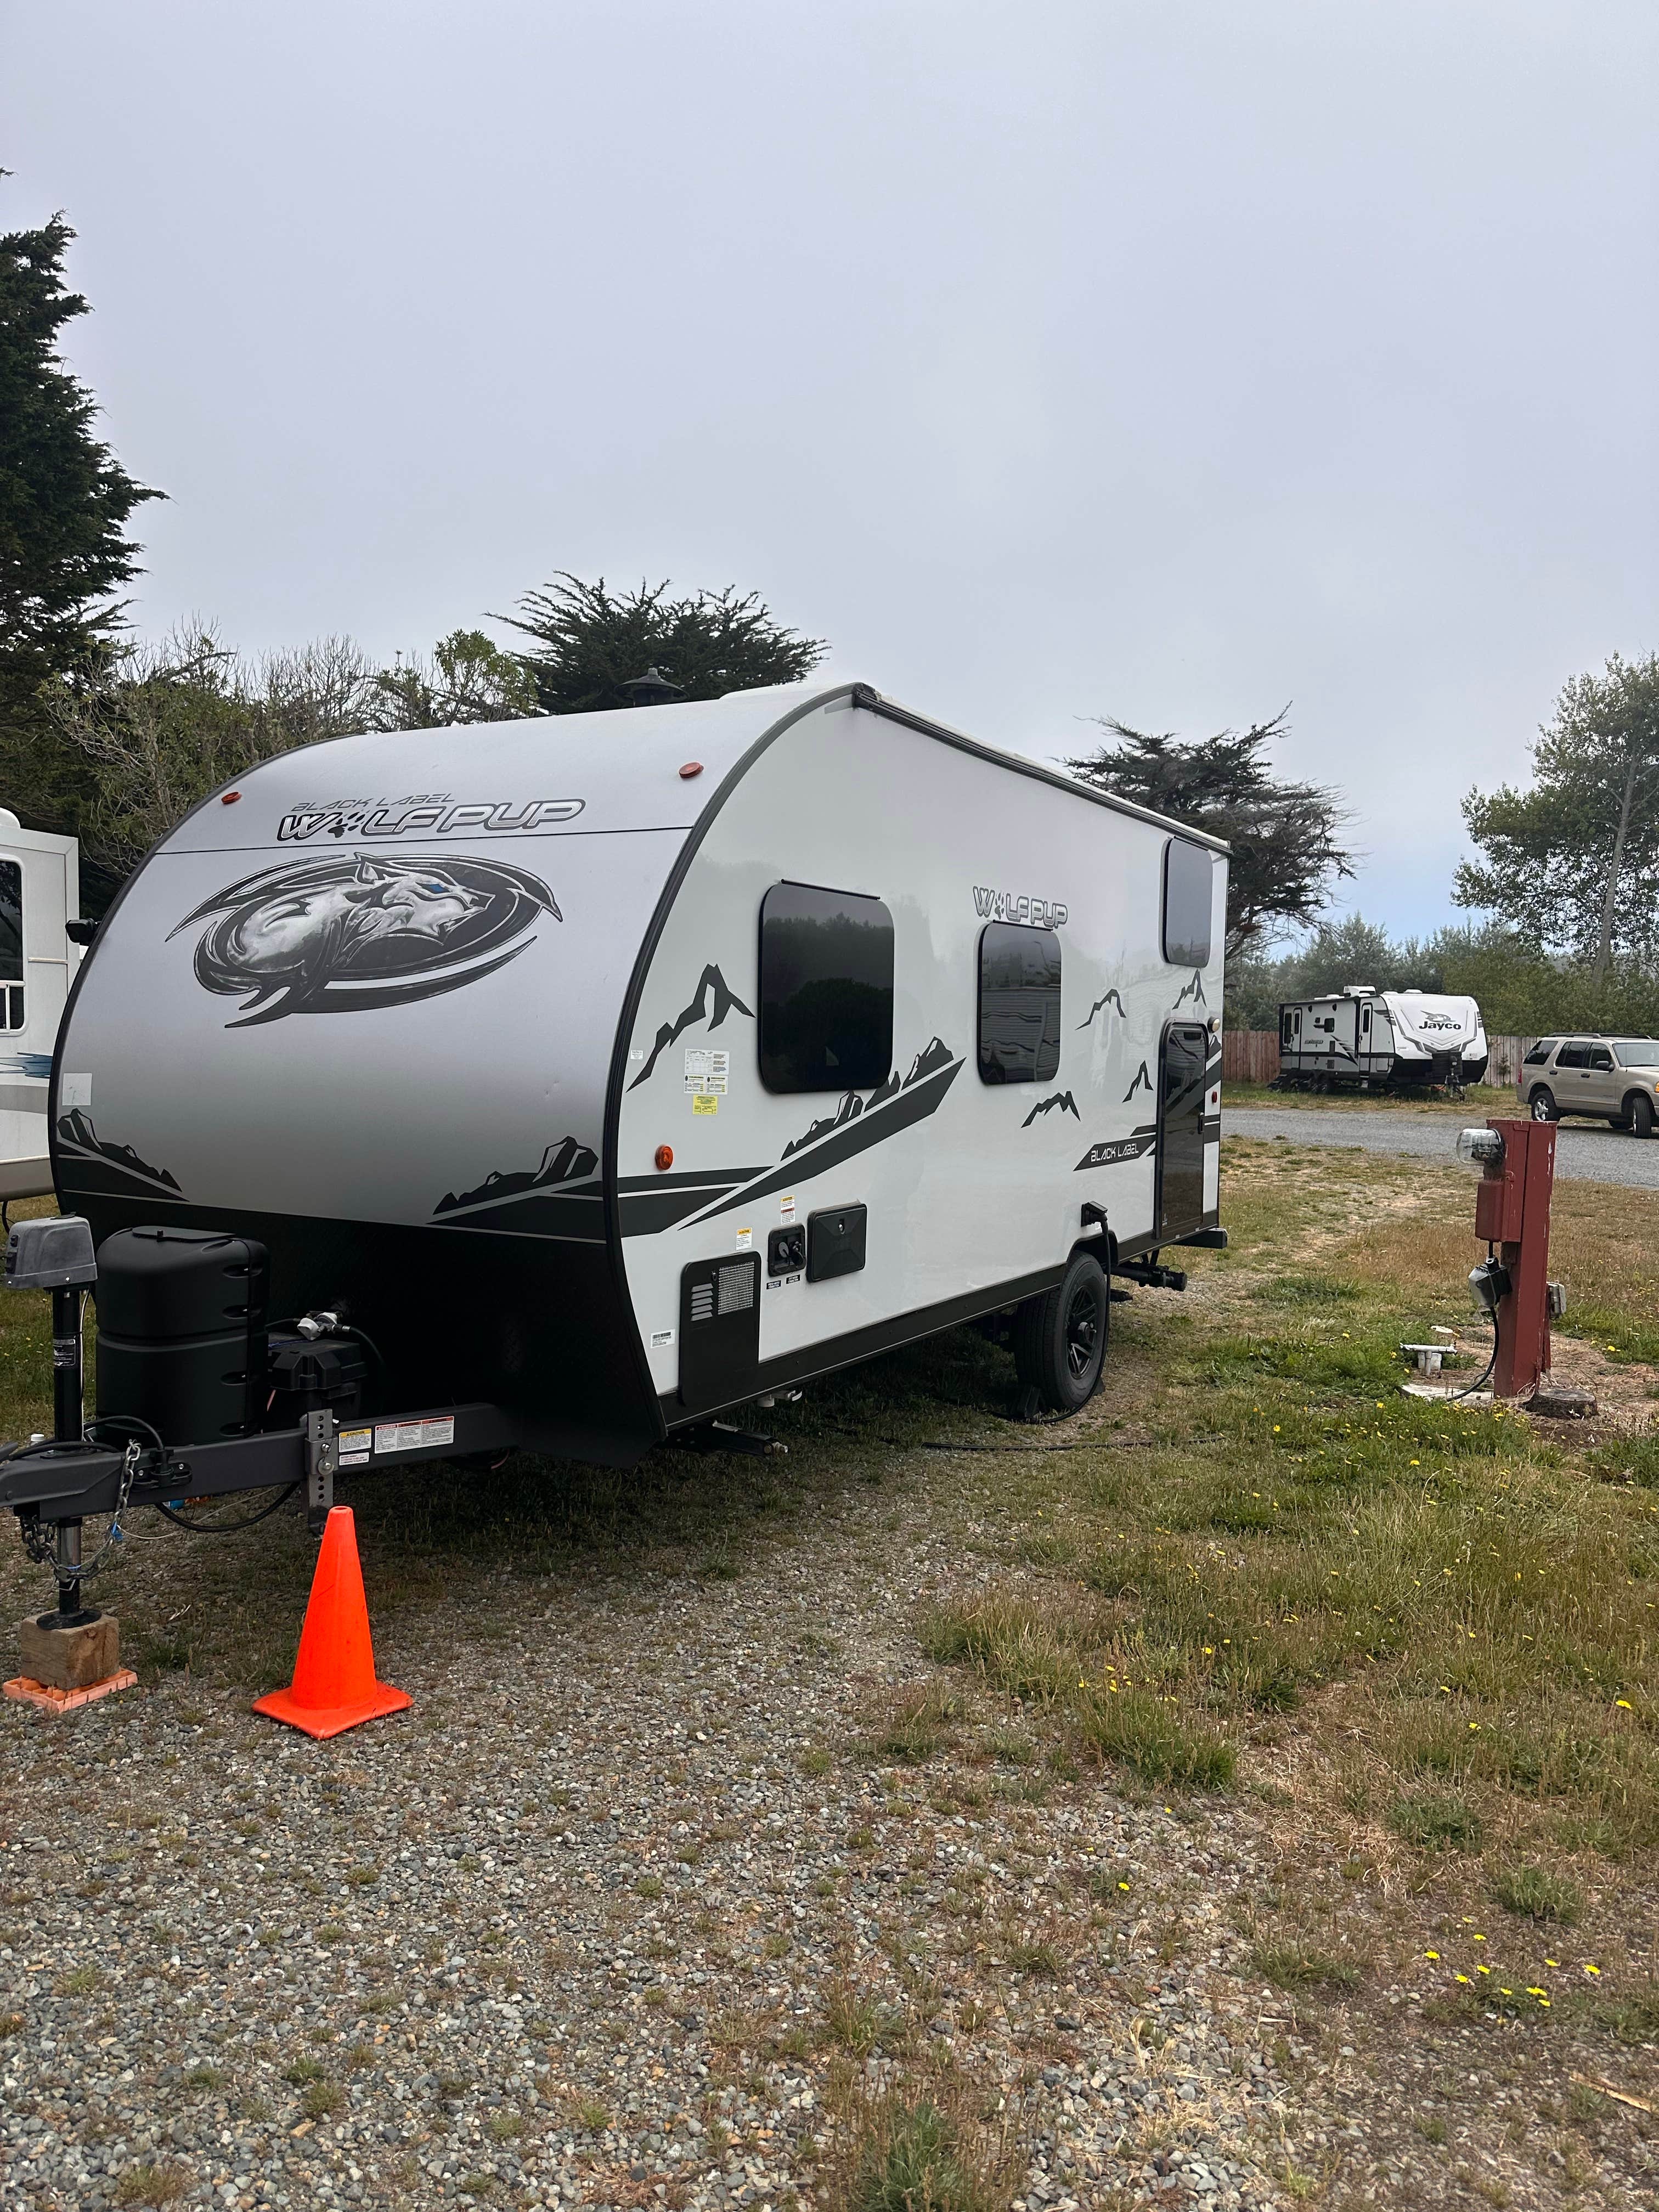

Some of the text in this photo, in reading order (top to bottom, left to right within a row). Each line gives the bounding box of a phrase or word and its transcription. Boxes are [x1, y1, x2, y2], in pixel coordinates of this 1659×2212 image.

[291, 793, 455, 811] BLACK LABEL
[436, 799, 586, 833] PUP
[1030, 898, 1068, 929] PUP
[1419, 1021, 1462, 1030] Jayco
[1091, 1143, 1139, 1162] BLACK LABEL
